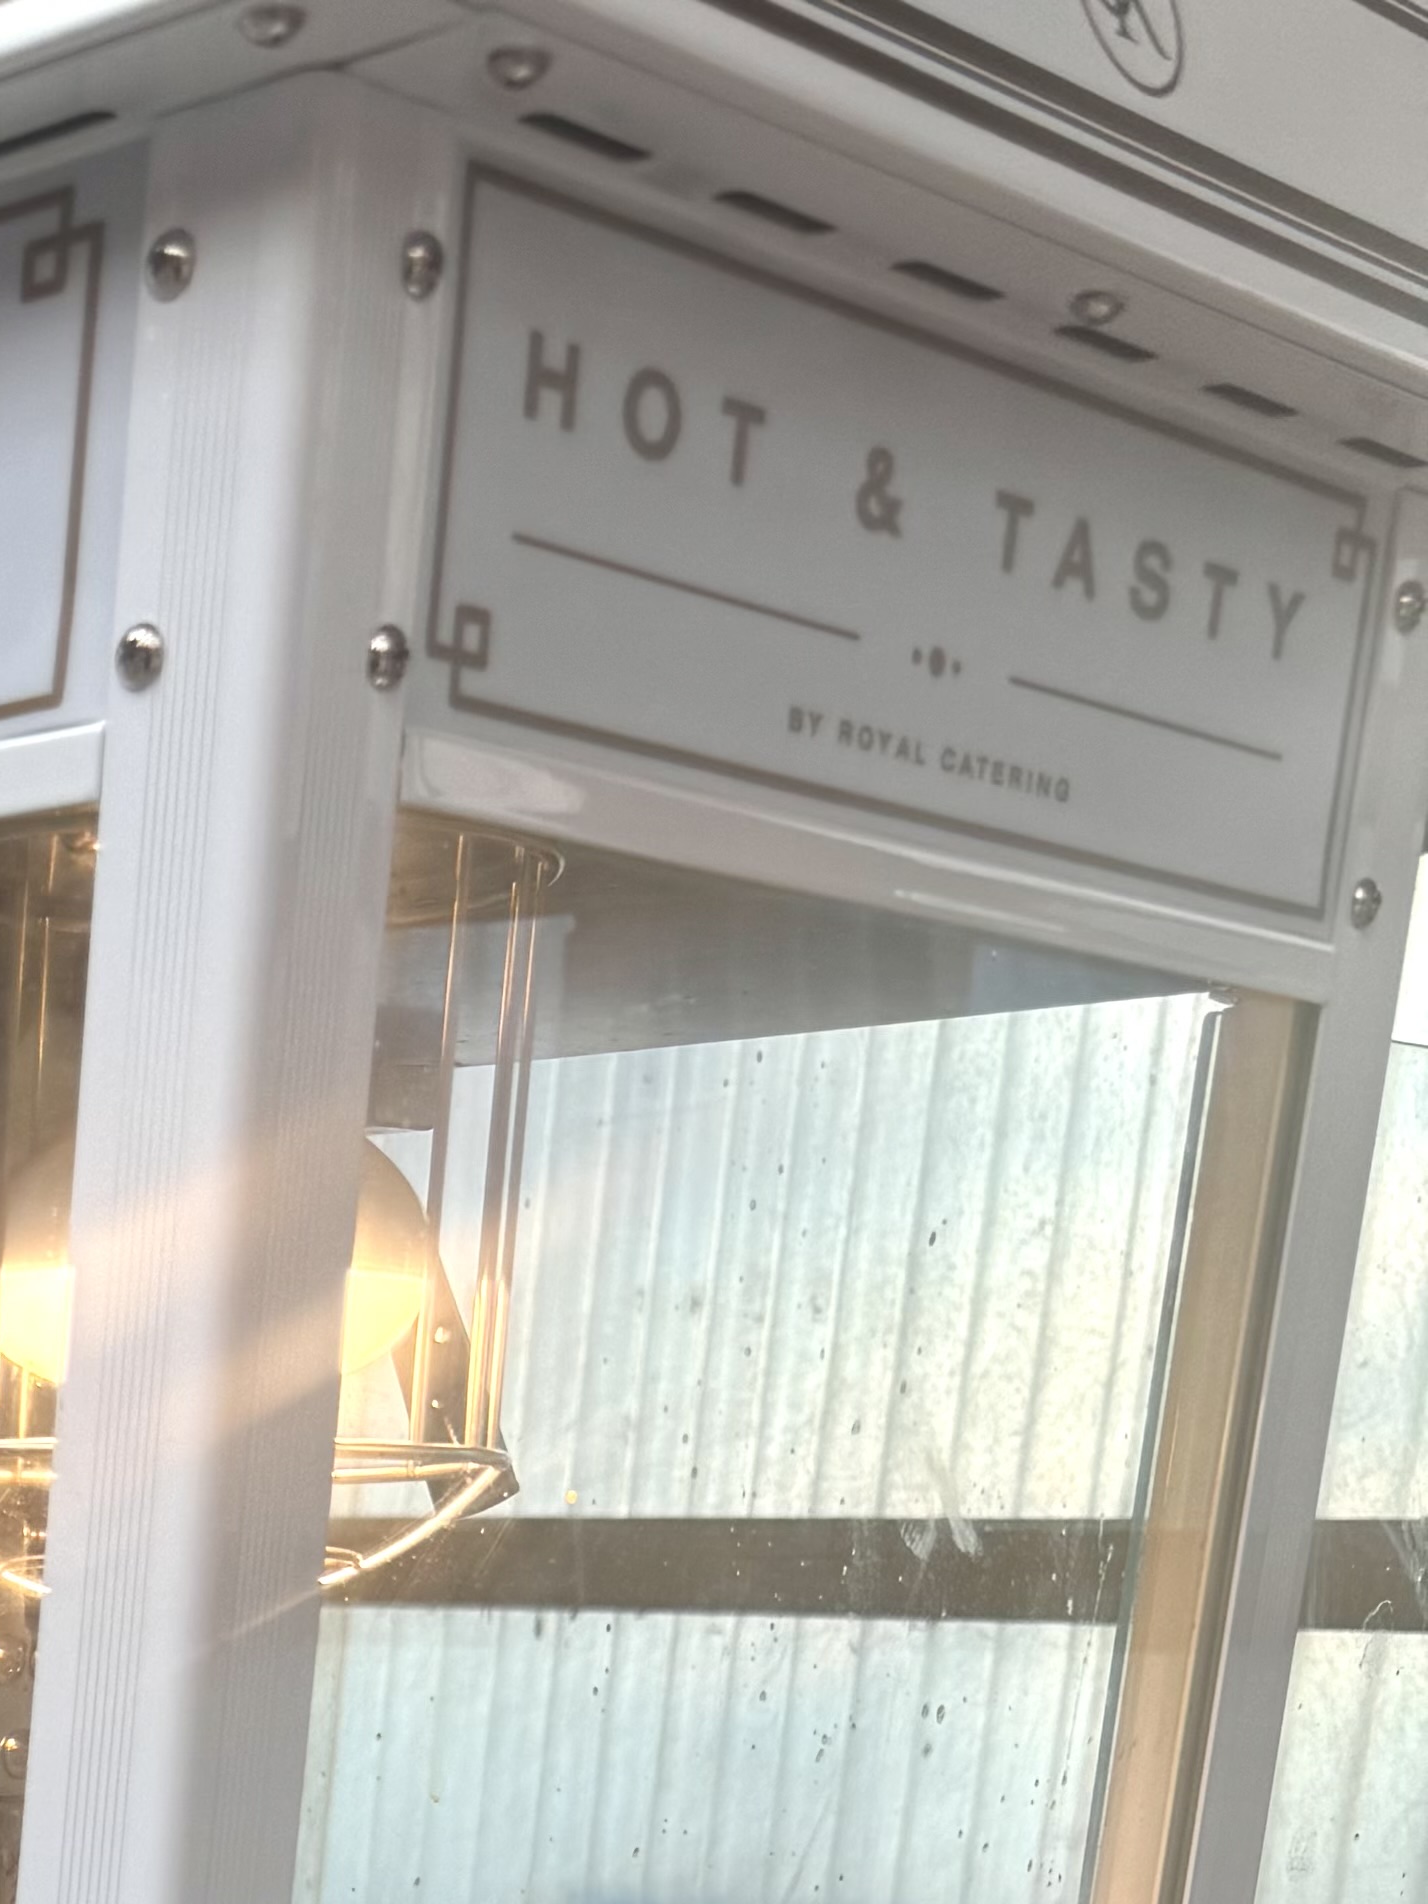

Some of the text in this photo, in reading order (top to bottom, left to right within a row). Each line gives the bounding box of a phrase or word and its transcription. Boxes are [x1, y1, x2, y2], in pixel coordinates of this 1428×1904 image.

[521, 329, 1306, 662] HOT & TASTY
[786, 704, 1071, 804] BY ROYAL CATERING
